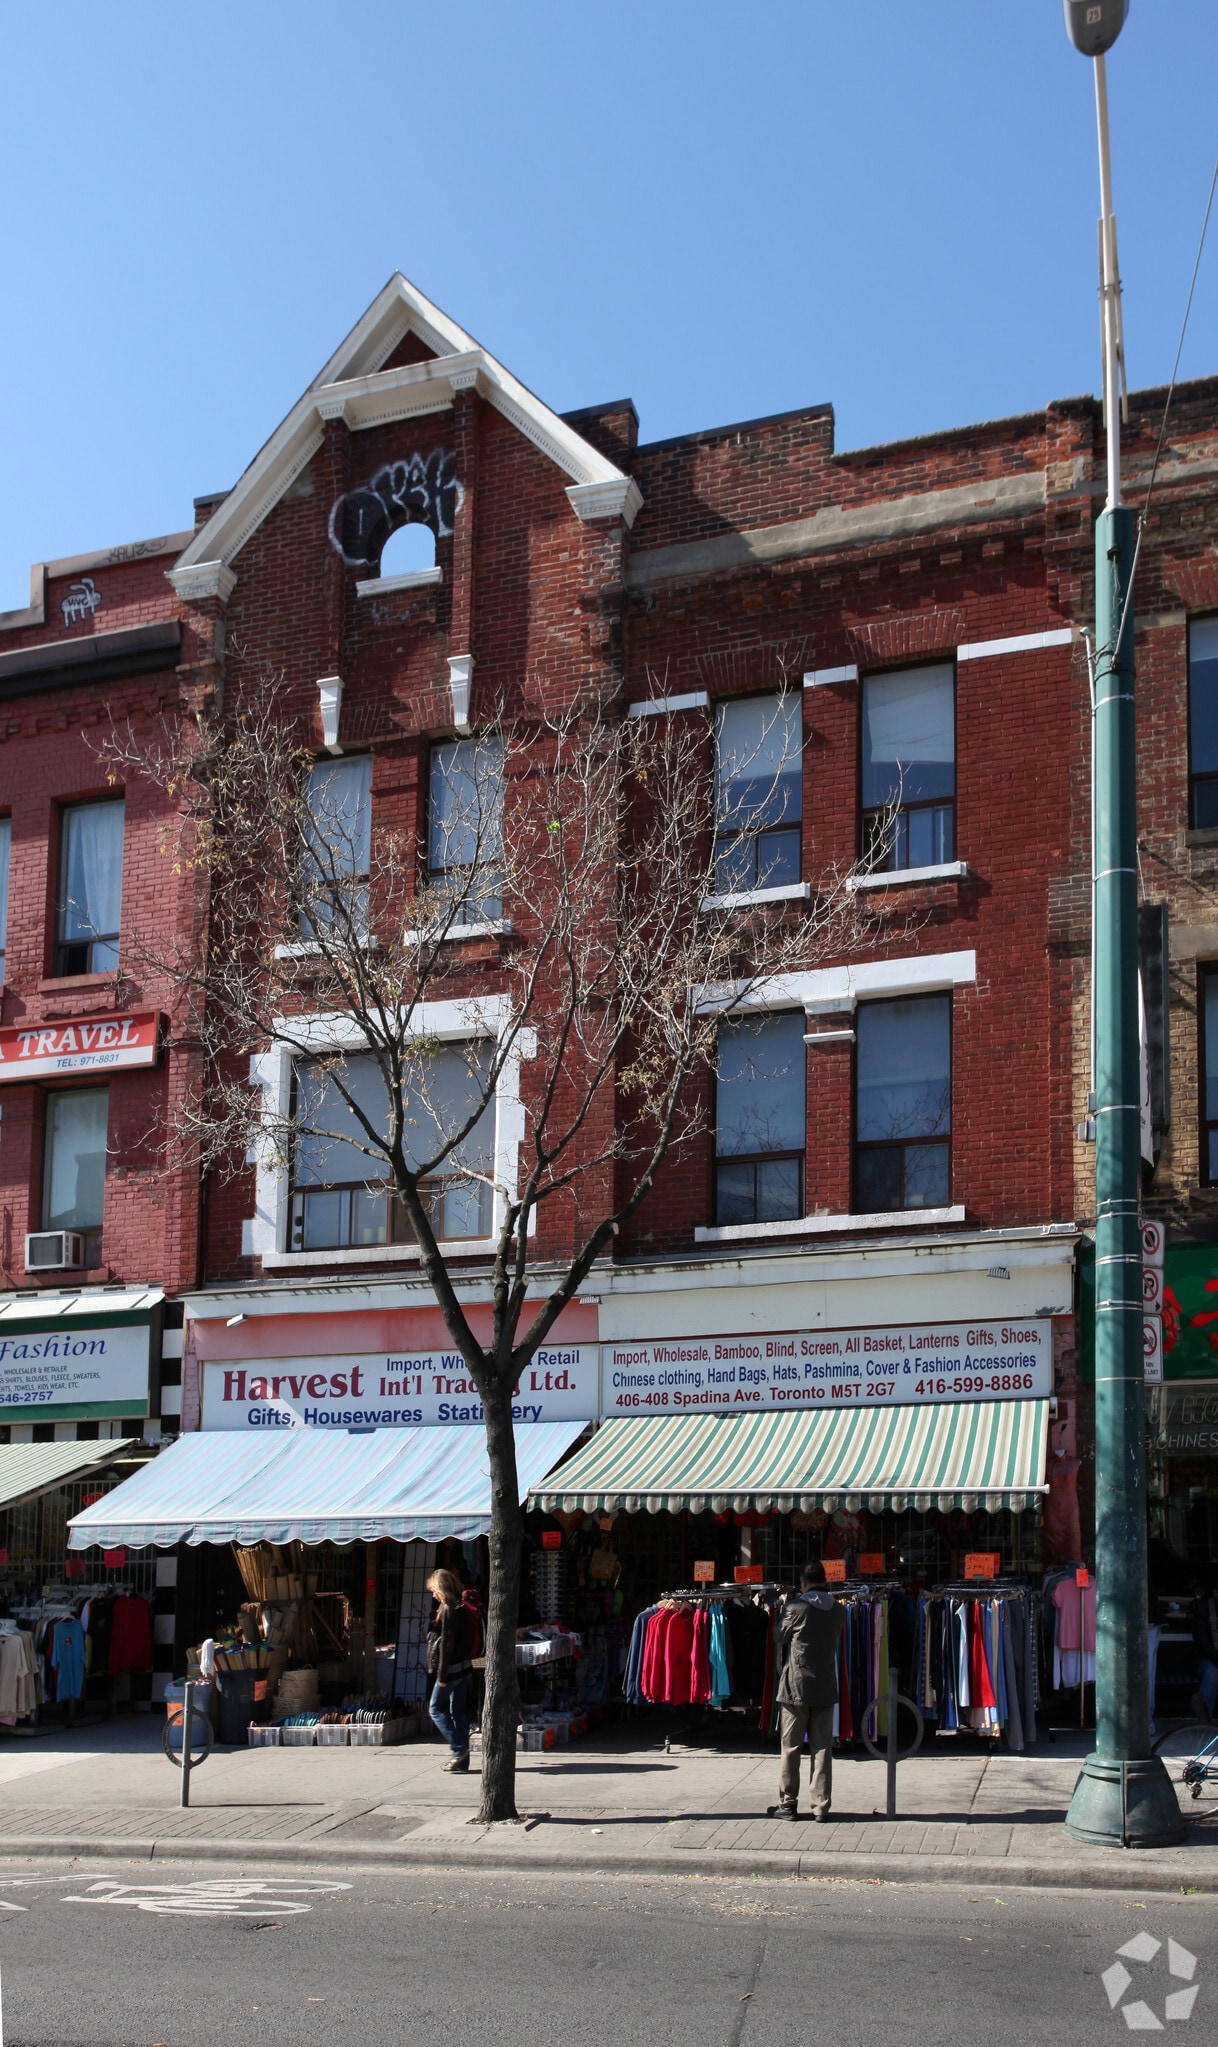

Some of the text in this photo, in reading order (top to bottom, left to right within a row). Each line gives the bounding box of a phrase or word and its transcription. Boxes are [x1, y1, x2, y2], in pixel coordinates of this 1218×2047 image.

[17, 1019, 139, 1057] TRAVEL
[57, 1054, 119, 1068] TEL: 971-8831
[0, 1335, 108, 1360] Fashion
[387, 1357, 436, 1374] Import,
[538, 1350, 580, 1366] Retail
[613, 1328, 1042, 1368] Import, Wholesale, Bamboo, Blind, Screen, All Basket, Lanterns Gifts, Shoes,
[222, 1365, 365, 1401] Harvest
[379, 1375, 422, 1396] Int'l
[530, 1370, 576, 1391] Ltd.
[658, 1369, 704, 1388] clothing,
[707, 1366, 736, 1384] Hand
[739, 1365, 770, 1384] Bags,
[773, 1364, 801, 1382] Hats,
[804, 1362, 863, 1380] Pashmina,
[866, 1360, 900, 1376] Cover
[903, 1358, 912, 1374] &
[915, 1355, 961, 1374] Fashion
[964, 1352, 1037, 1371] Accessories
[616, 1373, 1033, 1408] 406-408 Spadina Ave. Toronto M5T 2G7 416-599-8886
[247, 1403, 543, 1427] Gifts, Housewares Statiery
